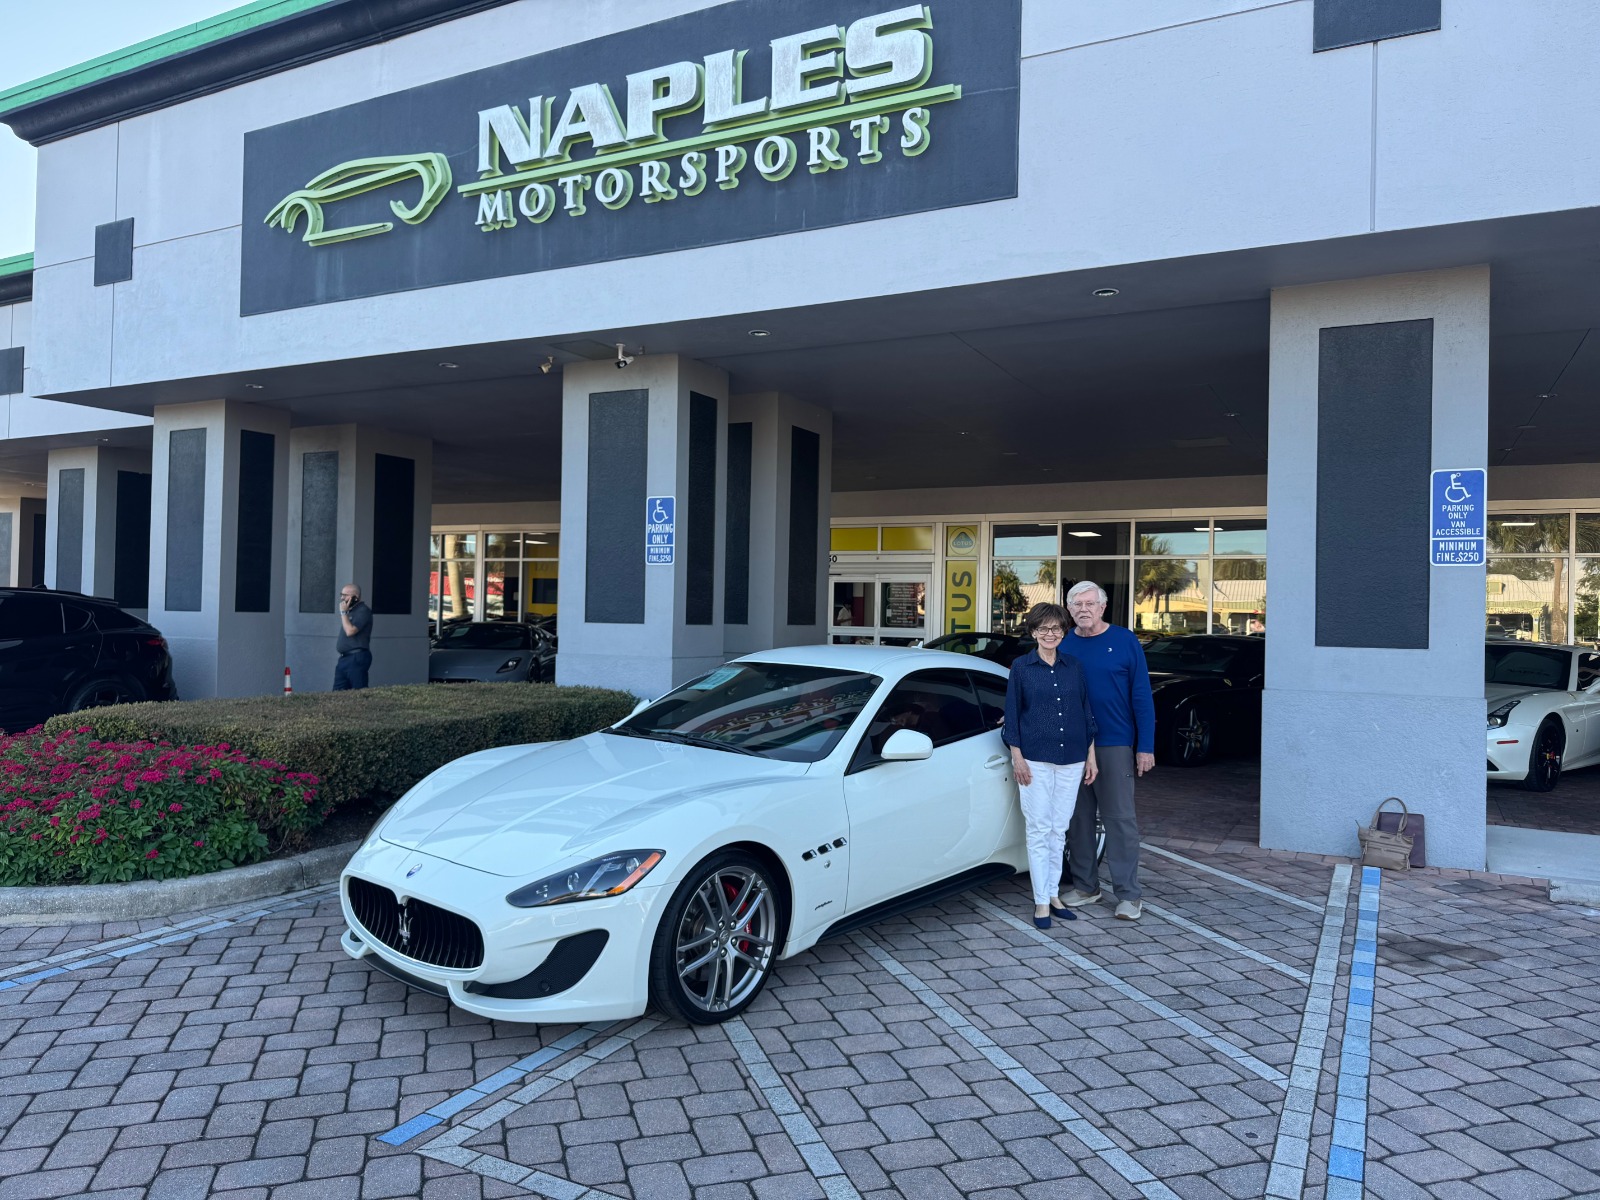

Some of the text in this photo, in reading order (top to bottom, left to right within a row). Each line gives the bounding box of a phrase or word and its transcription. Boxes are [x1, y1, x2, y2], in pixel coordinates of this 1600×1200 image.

[477, 4, 932, 176] NAPLES
[475, 107, 930, 230] MOTORSPORTS
[648, 524, 673, 533] PARKING
[652, 535, 668, 543] ONLY
[1439, 542, 1476, 551] MINIMUM
[1437, 552, 1478, 562] FINE $250
